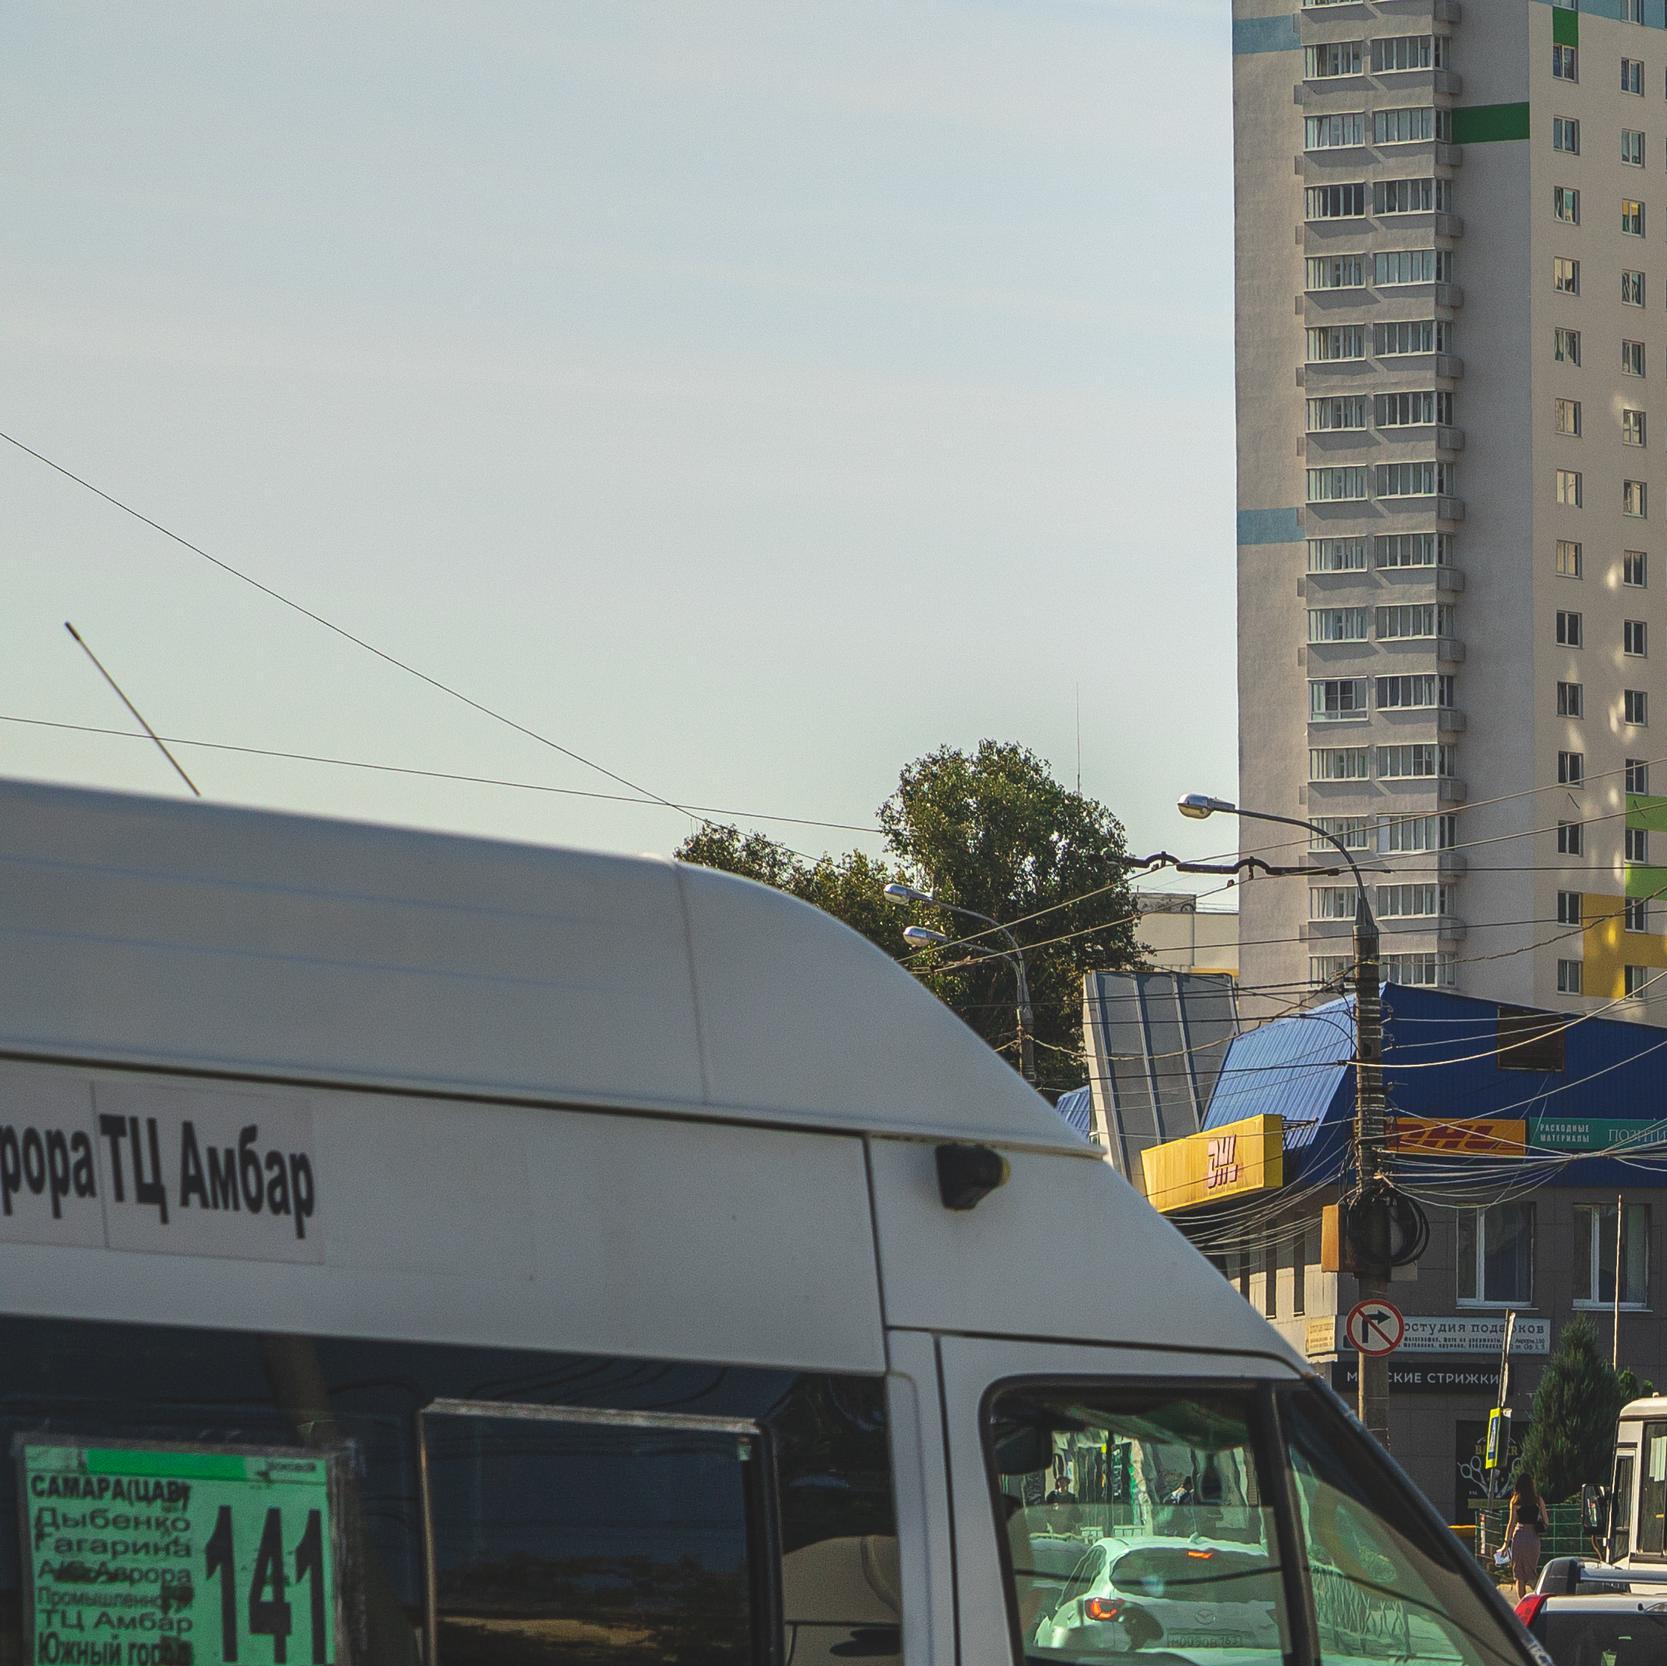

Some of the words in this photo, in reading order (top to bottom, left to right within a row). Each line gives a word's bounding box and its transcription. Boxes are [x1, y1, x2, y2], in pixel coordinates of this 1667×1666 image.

[1388, 1122, 1500, 1148] DHL
[0, 1124, 96, 1219] рора
[99, 1113, 169, 1225] ТЦ
[180, 1121, 315, 1240] Амбар
[1405, 1323, 1466, 1335] остудия
[1471, 1324, 1545, 1333] подаков
[1347, 1372, 1421, 1383] МСКИЕ
[1427, 1373, 1499, 1384] СТРИЖКИ
[34, 1507, 191, 1533] Дыбенко
[35, 1532, 192, 1558] Гагарина
[205, 1505, 327, 1665] 141
[39, 1610, 84, 1631] ТЦ
[94, 1611, 193, 1635] Амбар
[37, 1632, 122, 1666] Южный
